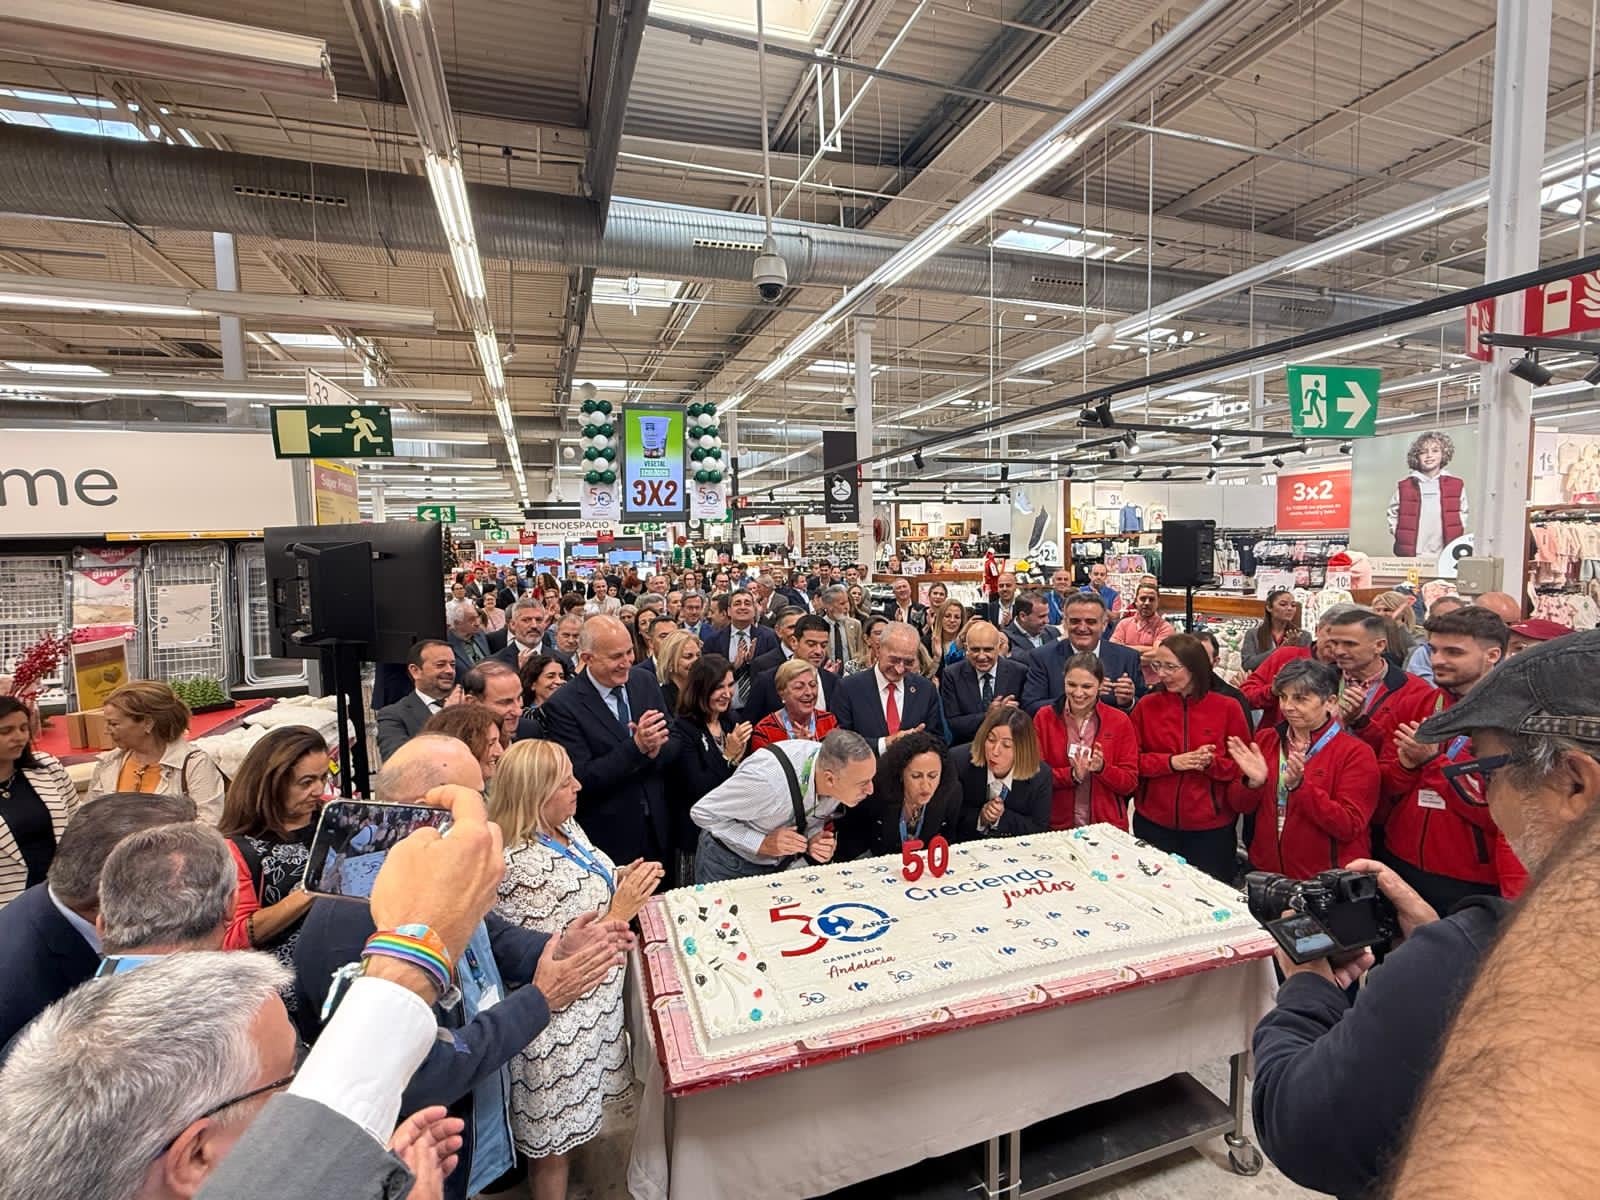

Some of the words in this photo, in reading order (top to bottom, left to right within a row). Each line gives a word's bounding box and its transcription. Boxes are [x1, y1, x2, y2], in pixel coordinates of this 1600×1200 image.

[632, 480, 678, 507] 3X2
[1293, 480, 1334, 501] 3x2
[532, 521, 609, 530] TECNOESPACIO
[92, 569, 118, 579] gimi
[902, 833, 949, 882] 50
[904, 867, 1054, 901] Creciendo
[1002, 878, 1077, 909] juntos
